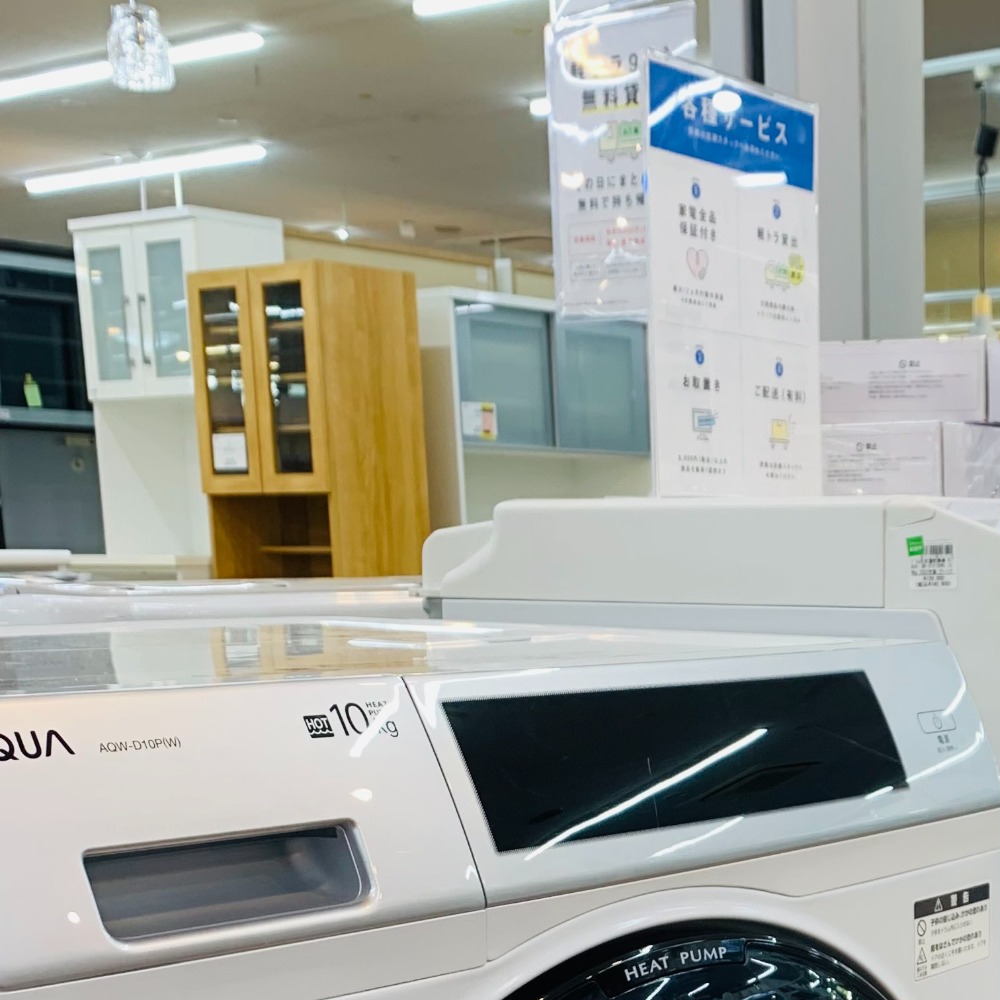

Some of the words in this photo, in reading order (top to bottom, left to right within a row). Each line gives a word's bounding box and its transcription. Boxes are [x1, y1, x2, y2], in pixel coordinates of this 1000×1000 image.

[304, 717, 331, 734] HOT
[329, 702, 370, 736] 10
[99, 736, 182, 753] AQW-D10P(W)
[624, 955, 669, 981] HEAT
[680, 946, 727, 964] PUMP
